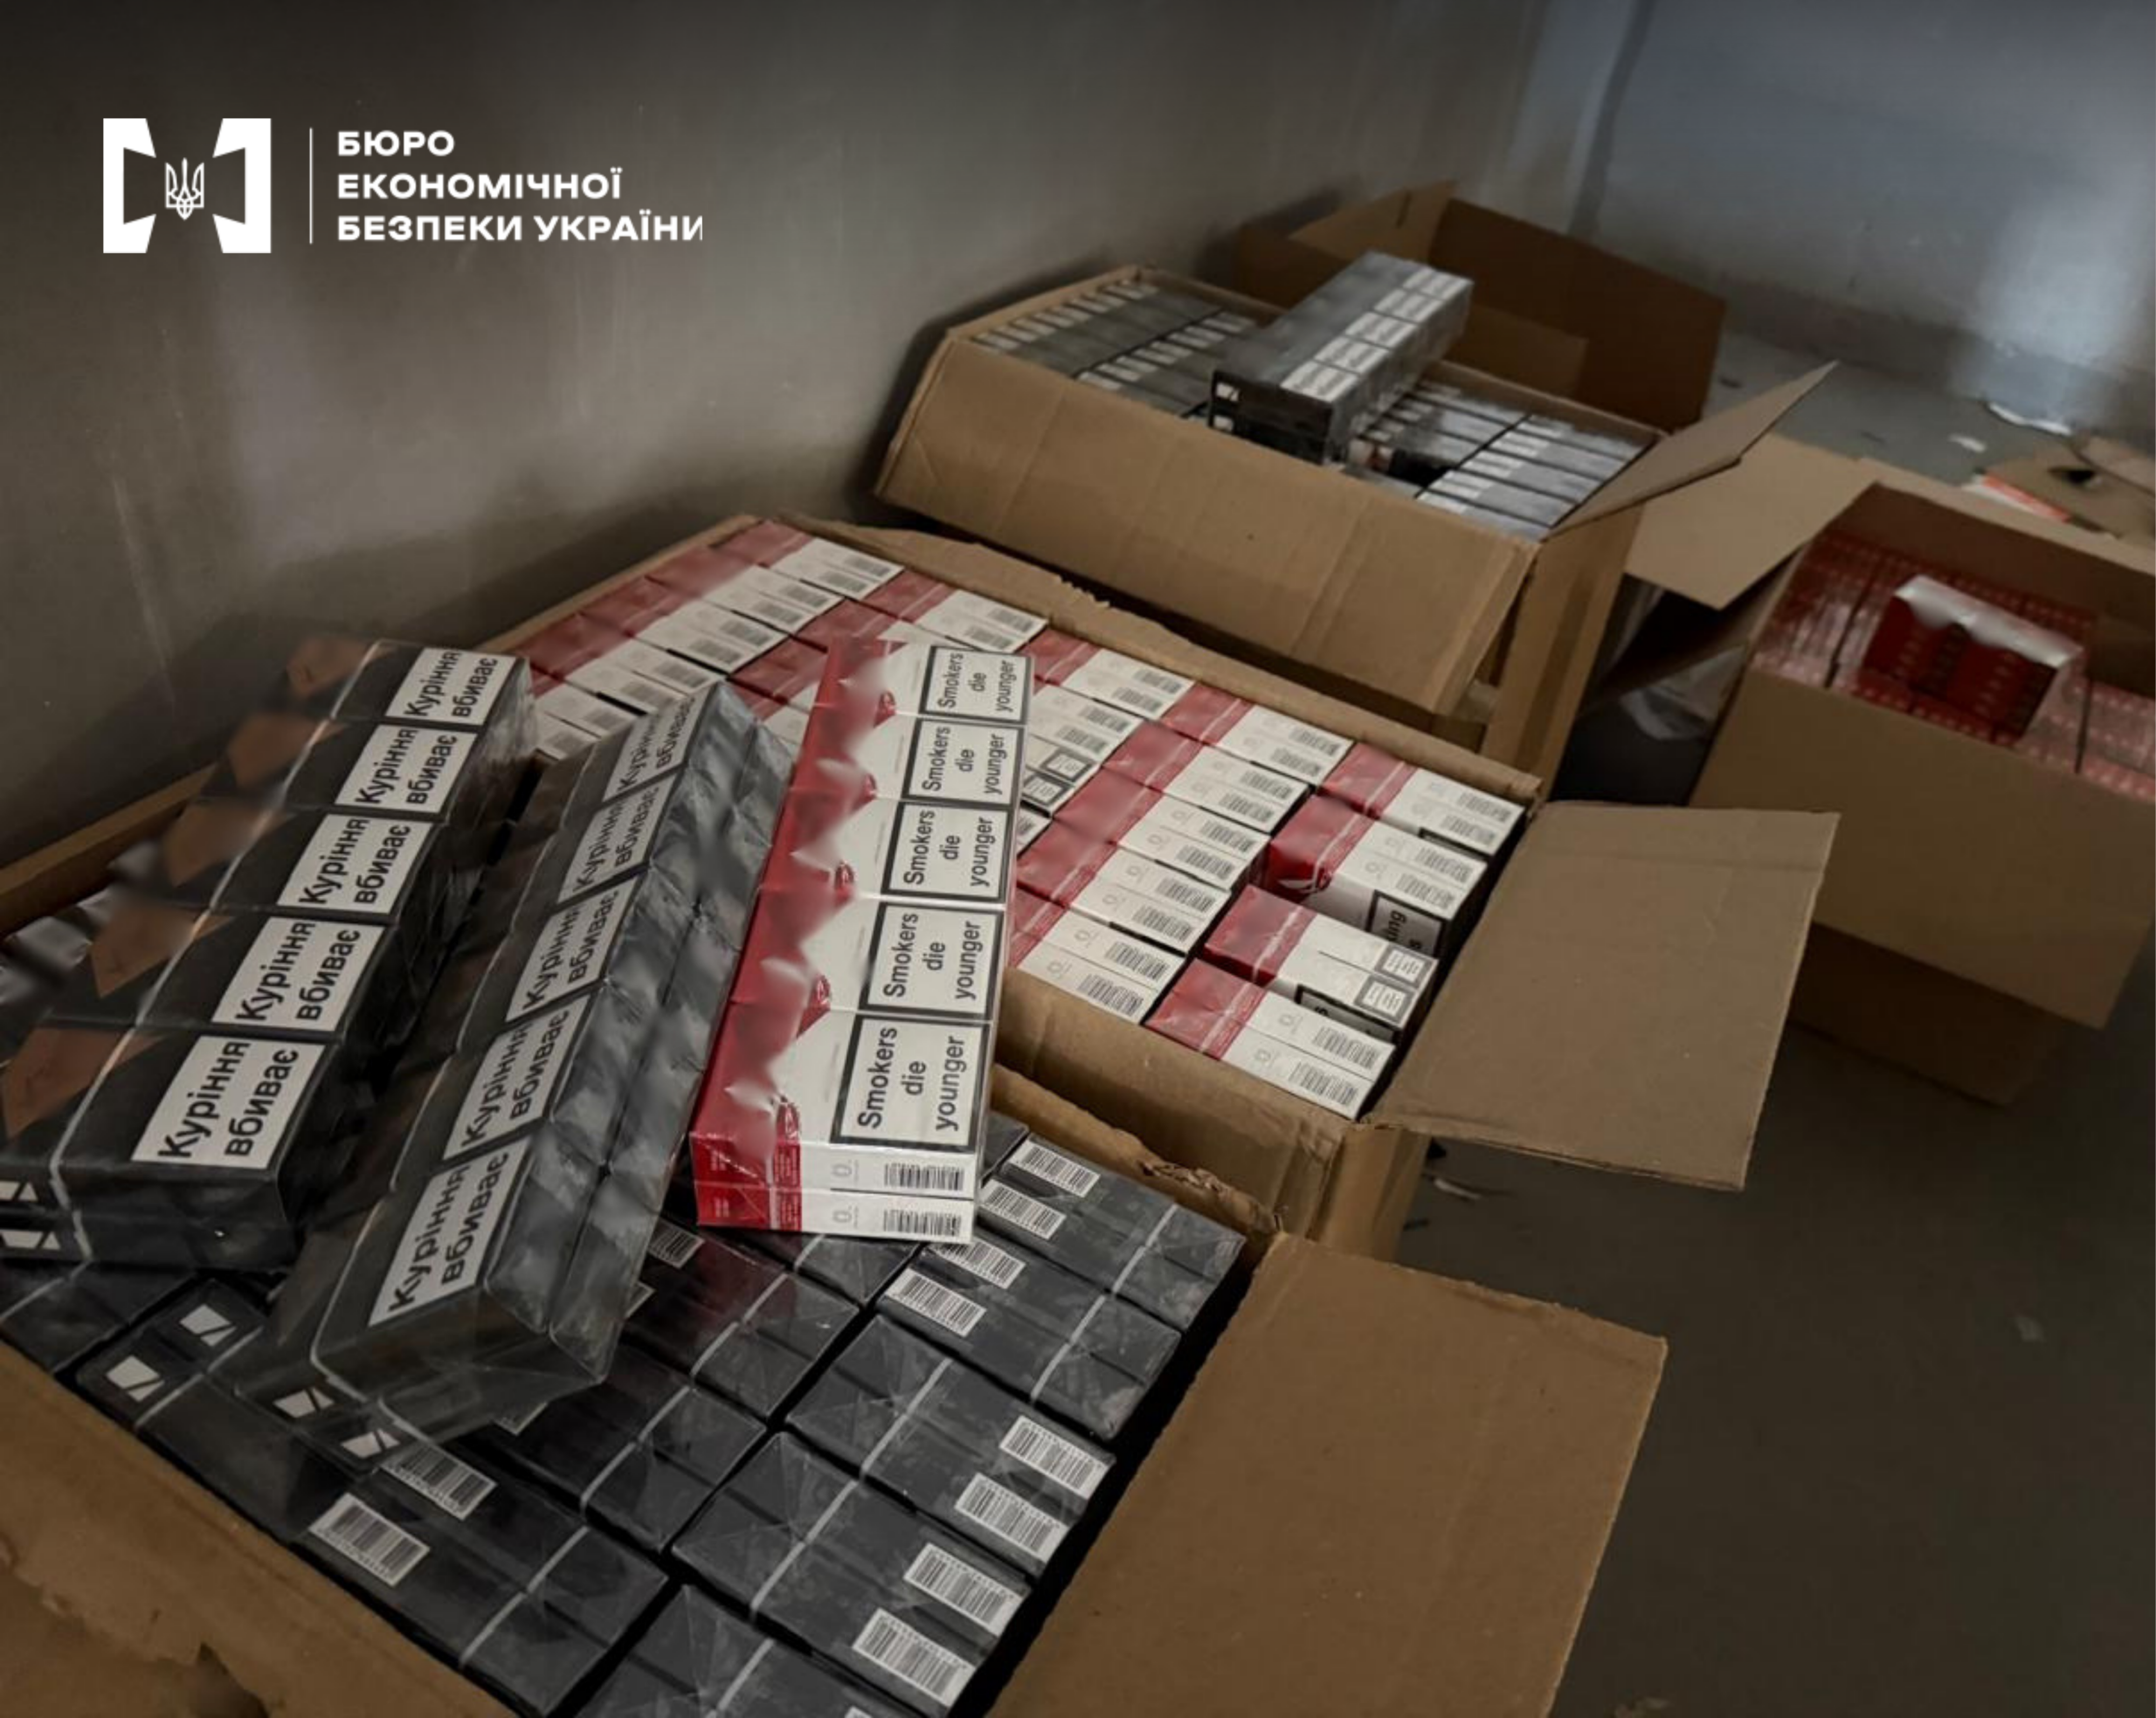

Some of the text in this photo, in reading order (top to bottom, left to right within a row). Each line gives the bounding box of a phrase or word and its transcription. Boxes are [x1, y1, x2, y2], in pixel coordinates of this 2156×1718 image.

[404, 650, 462, 716] Куріння
[452, 658, 498, 717] вбиває
[938, 652, 964, 709] Smokers
[968, 671, 985, 693] die
[996, 659, 1018, 713] younger
[354, 729, 418, 804] Куріння
[406, 735, 457, 804] вбиває
[922, 726, 951, 791] Smokers
[955, 748, 975, 772] die
[984, 733, 1009, 796] younger
[299, 819, 370, 904] Куріння
[354, 826, 410, 904] вбиває
[904, 809, 936, 885] Smokers
[939, 834, 962, 860] die
[970, 816, 996, 888] younger
[235, 922, 316, 1020] Куріння
[296, 929, 361, 1020] вбиває
[883, 913, 918, 998] Smokers
[922, 941, 946, 971] die
[956, 921, 983, 1001] younger
[158, 1041, 251, 1157] Куріння
[510, 1010, 569, 1120] вбиває
[857, 1027, 898, 1129] Smokers
[900, 1060, 927, 1096] die
[936, 1036, 966, 1132] younger
[224, 1050, 298, 1156] вбиває
[441, 1153, 509, 1284] вбиває
